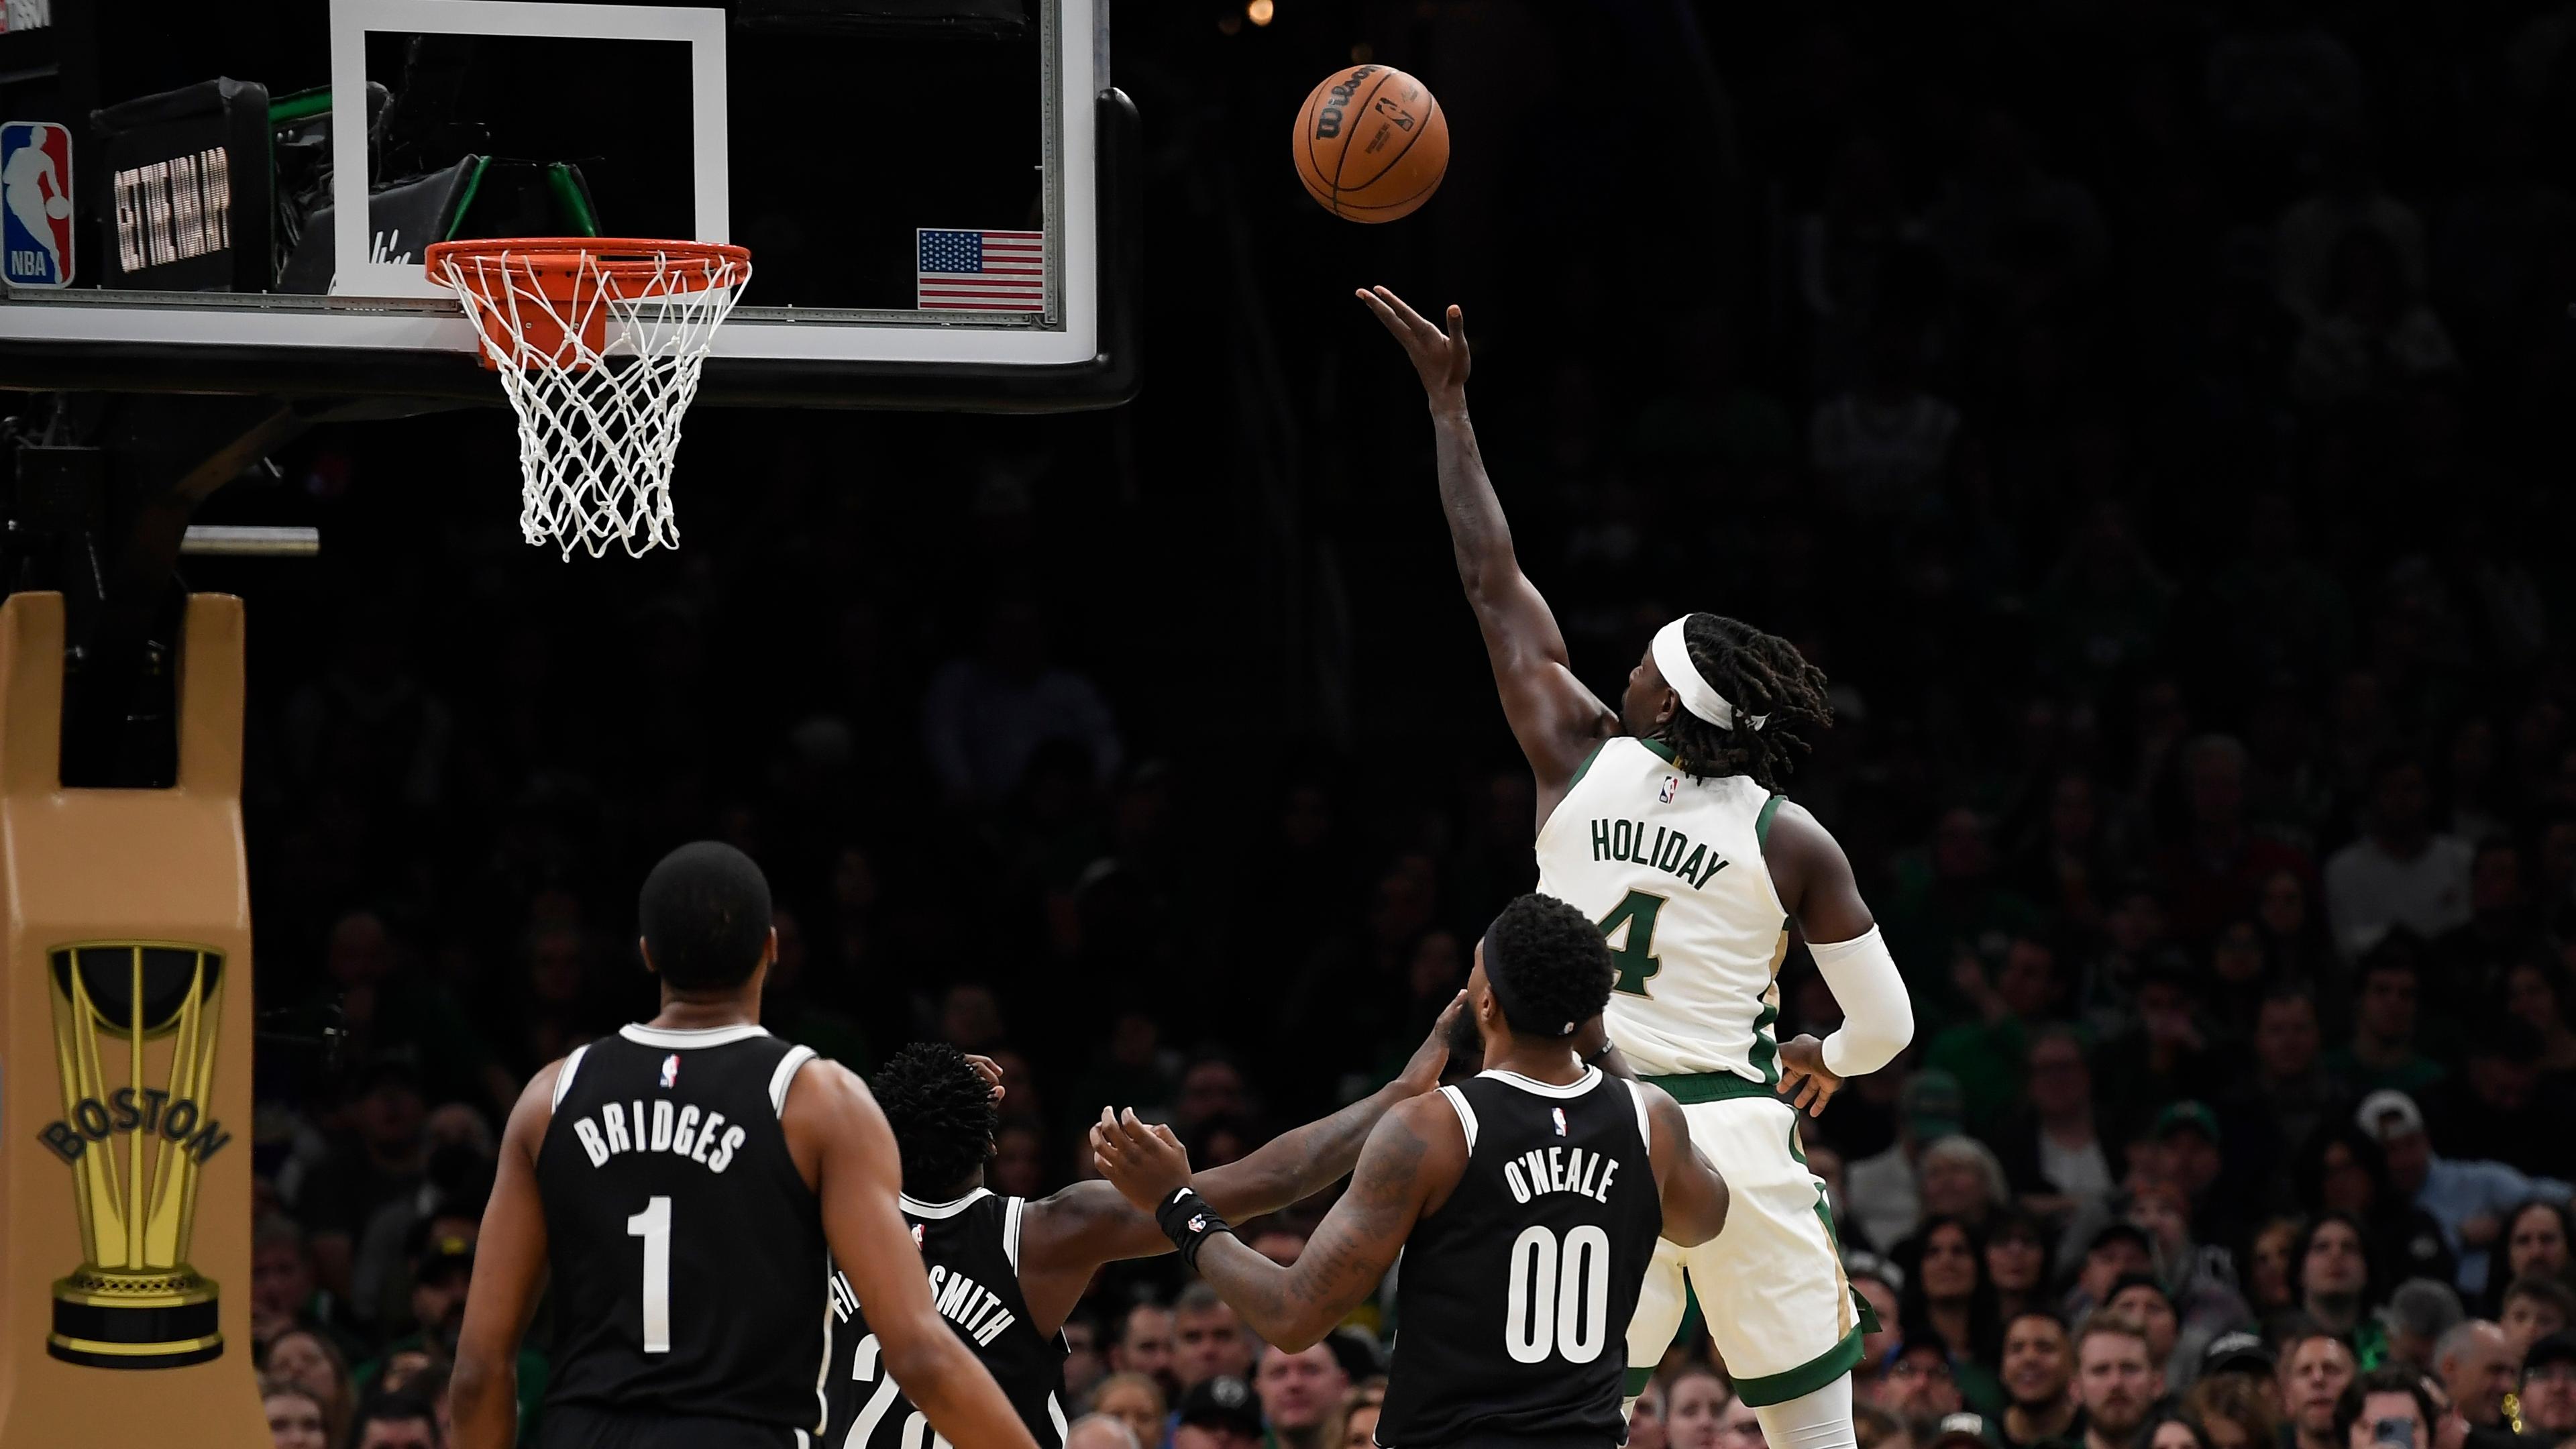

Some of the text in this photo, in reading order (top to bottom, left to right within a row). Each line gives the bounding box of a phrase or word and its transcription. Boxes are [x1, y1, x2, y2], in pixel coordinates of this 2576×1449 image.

[1316, 65, 1383, 140] Wilson
[11, 250, 46, 276] NBA
[1591, 818, 1730, 891] HOLIDAY
[1596, 886, 1670, 1001] 4
[38, 1087, 231, 1166] BOSTON
[574, 1098, 746, 1174] BRIDGES
[1503, 1146, 1619, 1204] O'NEALE
[627, 1195, 671, 1354] 1
[1505, 1225, 1610, 1364] 00
